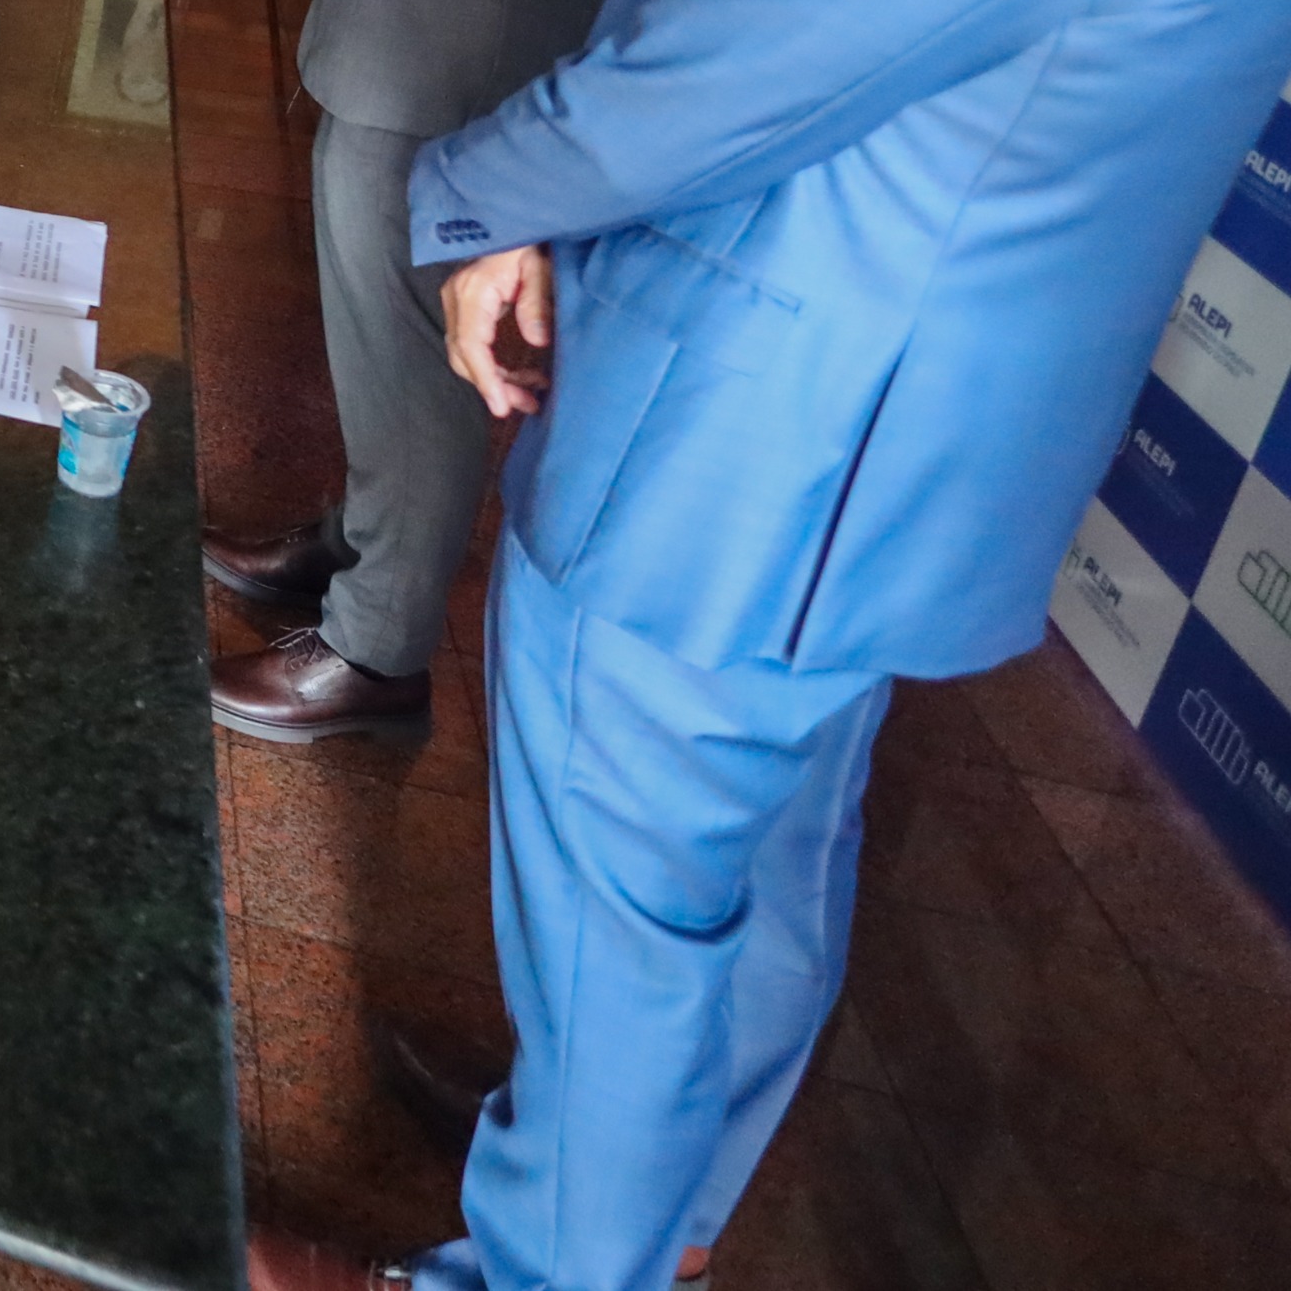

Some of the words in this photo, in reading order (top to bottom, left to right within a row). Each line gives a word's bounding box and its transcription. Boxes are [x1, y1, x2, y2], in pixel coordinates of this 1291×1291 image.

[1188, 293, 1232, 338] ALEPI
[1134, 428, 1176, 477] ALEPI
[1083, 556, 1122, 606] ALEPI
